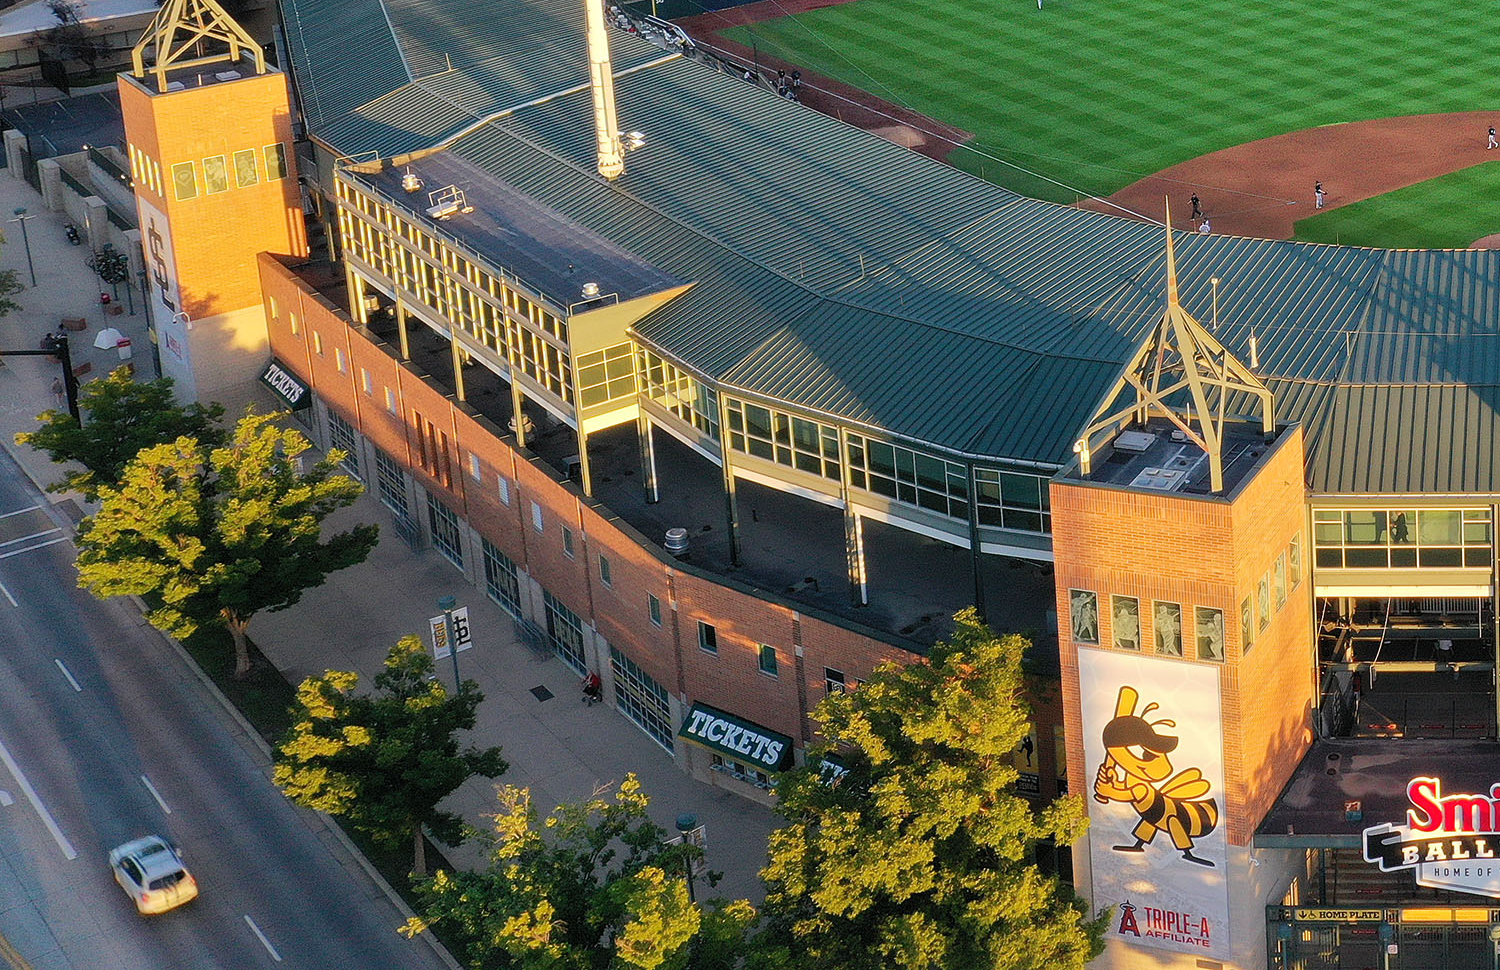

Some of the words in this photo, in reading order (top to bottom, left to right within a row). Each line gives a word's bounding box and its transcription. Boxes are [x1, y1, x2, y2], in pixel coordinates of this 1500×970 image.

[263, 363, 304, 404] TICKETS
[687, 709, 784, 766] TICKETS
[1433, 867, 1470, 877] HOME
[1477, 867, 1492, 877] OF
[1144, 906, 1210, 938] TRIPLE-A
[1319, 911, 1347, 919] HOME
[1350, 911, 1379, 919] PLATE
[1145, 929, 1211, 948] AFFILIATE
